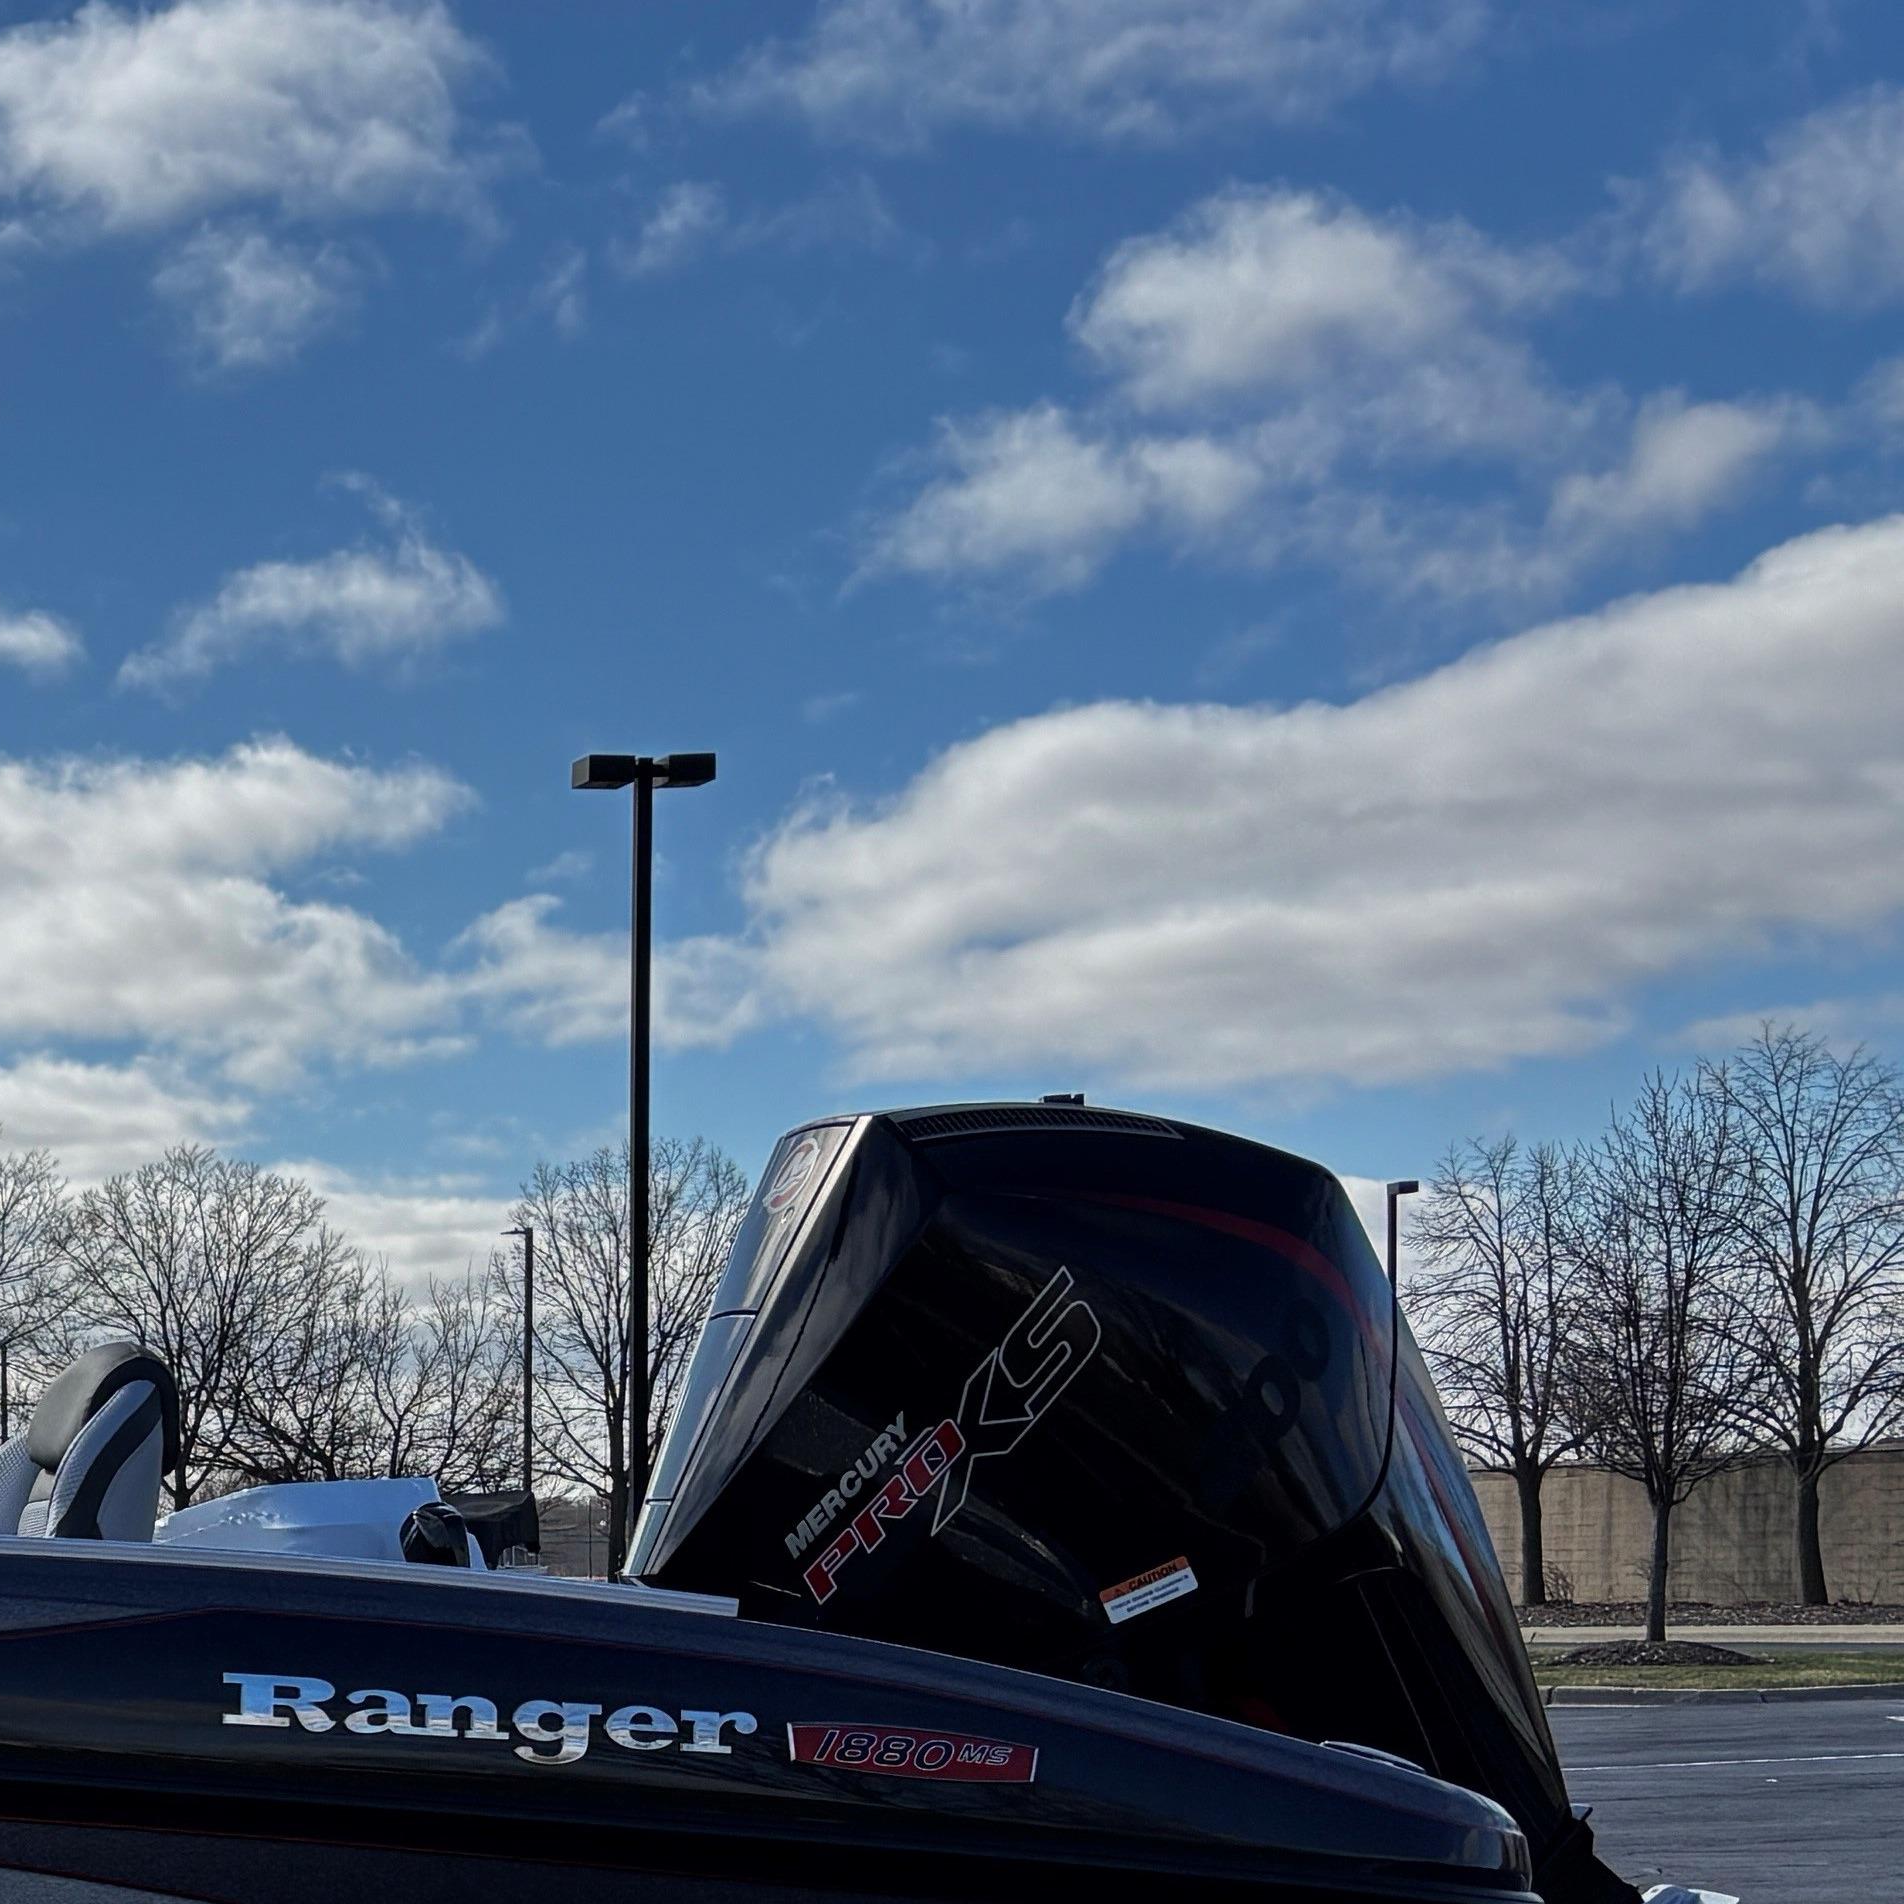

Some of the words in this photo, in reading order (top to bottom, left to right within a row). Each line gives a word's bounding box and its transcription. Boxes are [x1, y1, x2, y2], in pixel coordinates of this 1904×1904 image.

[784, 1410, 908, 1559] MERCURY
[803, 1418, 966, 1605] PRO
[893, 1264, 1102, 1537] XS
[222, 1671, 759, 1765] Ranger
[812, 1729, 956, 1772] 1880
[956, 1743, 1014, 1767] MS
